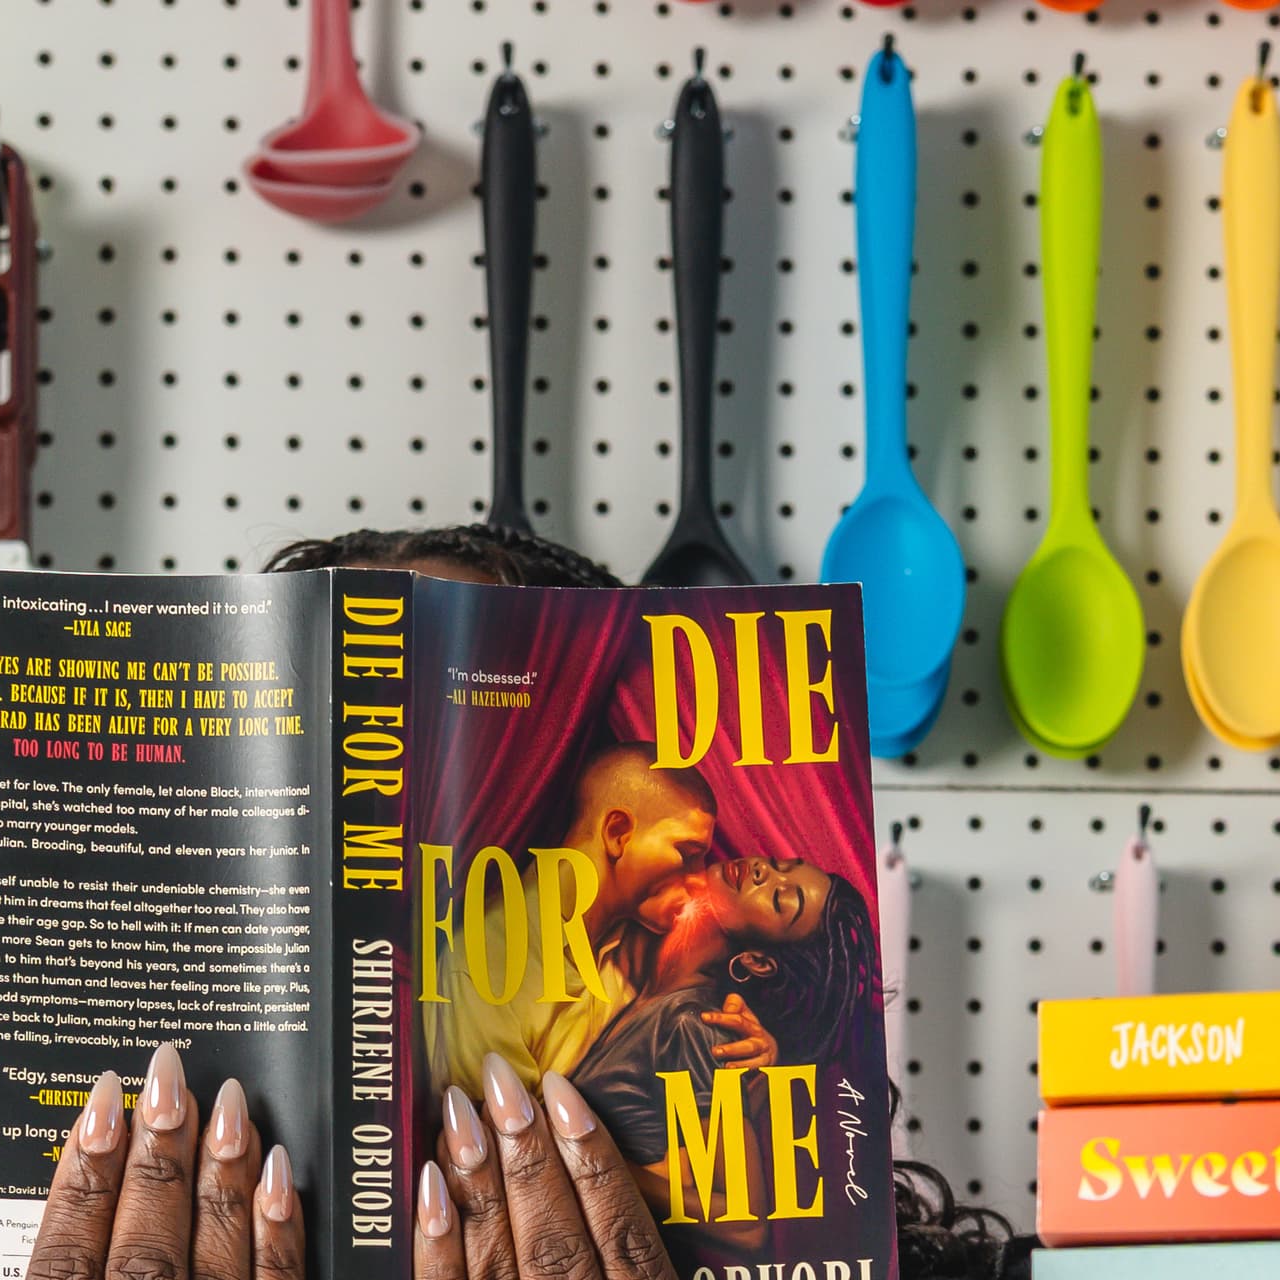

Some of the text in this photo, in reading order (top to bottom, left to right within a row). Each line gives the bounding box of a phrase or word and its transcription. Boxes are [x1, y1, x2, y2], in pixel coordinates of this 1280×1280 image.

[113, 603, 154, 615] never
[156, 601, 209, 615] wanted
[213, 602, 222, 615] it
[224, 602, 237, 614] to
[105, 620, 132, 638] SAGE
[25, 657, 52, 677] ARE
[58, 659, 120, 680] SHOWING
[127, 661, 146, 681] ME
[153, 661, 191, 681] CAN’T
[197, 662, 213, 682] BE
[221, 662, 279, 681] POSSIBLE.
[10, 683, 66, 705] BECAUSE
[73, 687, 87, 706] IF
[94, 687, 108, 707] IT
[115, 688, 132, 711] IS,
[139, 689, 174, 708] THEN
[181, 690, 186, 709] I
[194, 690, 225, 709] HAVE
[232, 690, 247, 708] TO
[254, 688, 294, 708] ACCEPT
[472, 690, 531, 708] HAZELWOOD
[642, 609, 840, 770] DIE
[34, 712, 60, 732] HAS
[67, 713, 101, 734] BEEN
[108, 715, 146, 735] ALIVE
[153, 716, 178, 736] FOR
[184, 717, 193, 736] A
[200, 717, 232, 736] VERY
[239, 717, 268, 736] LONG
[275, 715, 304, 735] TIME.
[13, 738, 186, 763] TOO LONG TO BE HUMAN.
[13, 778, 31, 791] for
[33, 780, 60, 792] love.
[61, 781, 84, 793] The
[86, 783, 111, 797] only
[113, 783, 156, 798] female,
[158, 785, 173, 797] let
[175, 785, 208, 797] alone
[210, 786, 242, 799] Black,
[342, 595, 404, 1250] DIE FOR ME SHIRLENE OBUOBI
[418, 843, 613, 1005] FOR
[1110, 1018, 1244, 1070] JACKSON
[2, 1126, 22, 1140] up
[25, 1123, 57, 1142] long
[656, 1064, 825, 1225] ME
[837, 1076, 863, 1207] A Novel
